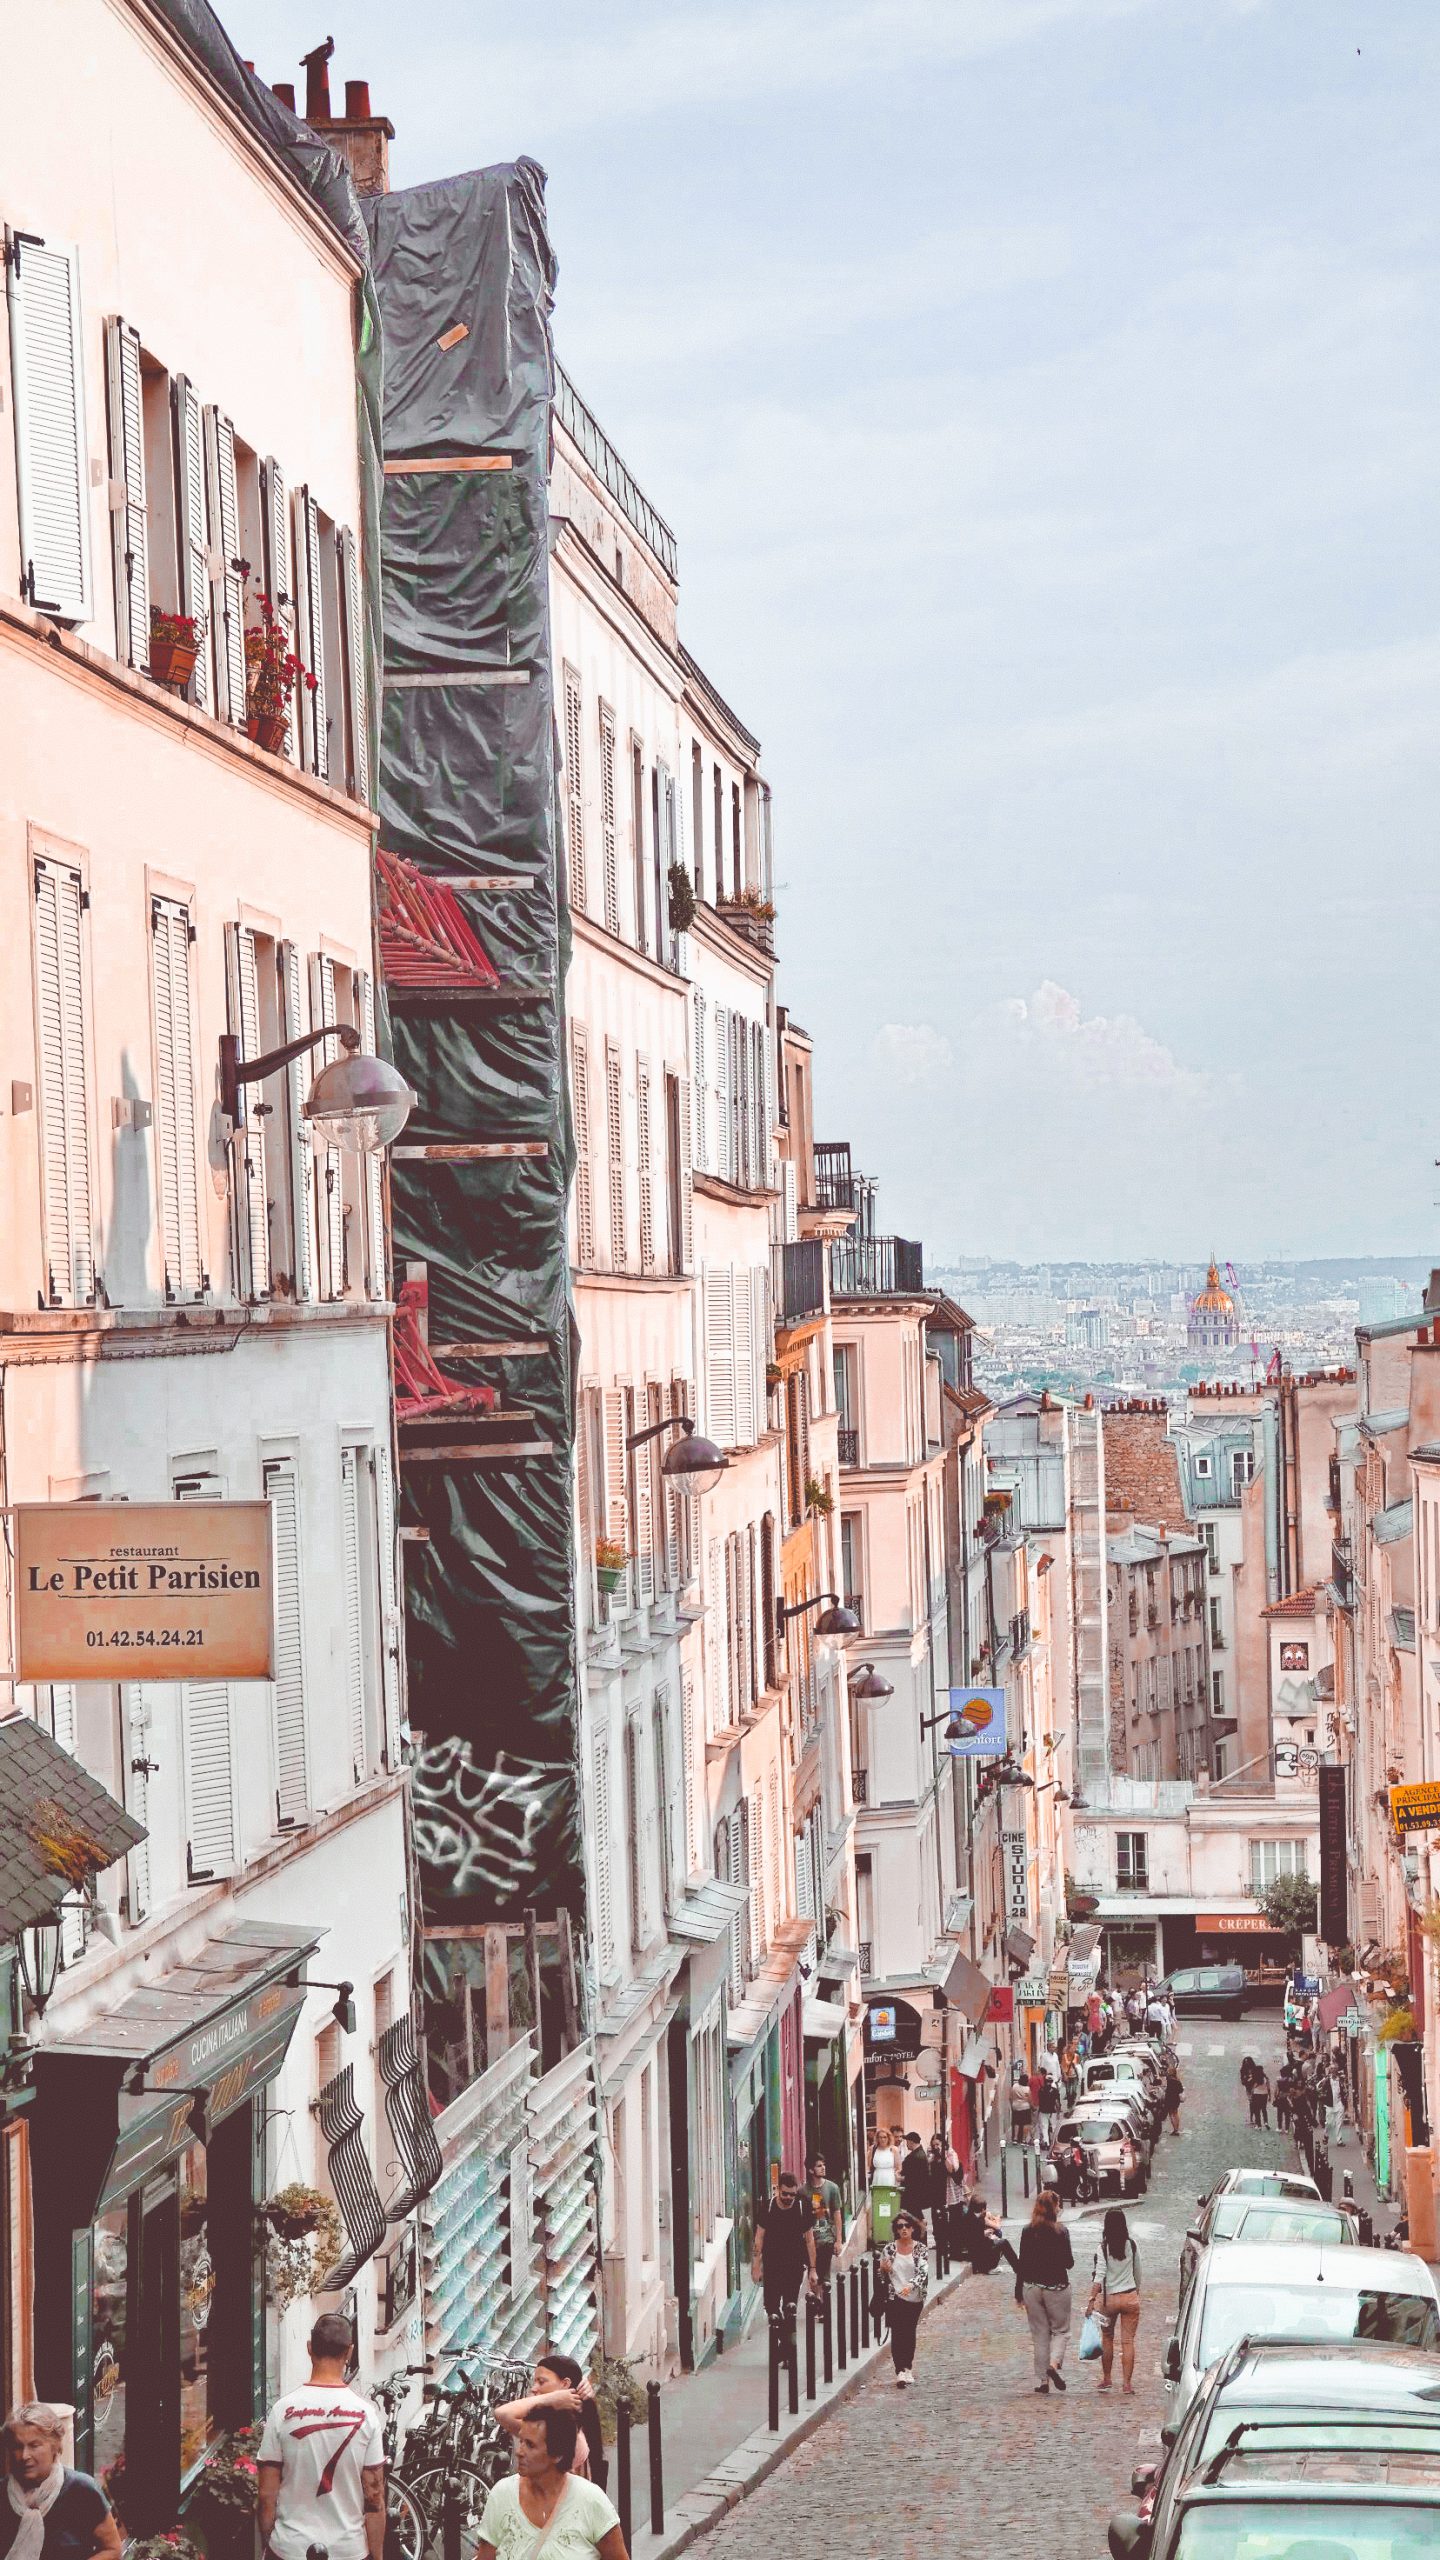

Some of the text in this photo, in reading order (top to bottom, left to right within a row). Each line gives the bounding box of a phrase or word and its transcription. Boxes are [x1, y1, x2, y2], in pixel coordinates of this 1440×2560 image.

[110, 1546, 180, 1557] restaurant
[28, 1563, 261, 1591] Le Petit Parisien
[86, 1629, 204, 1647] 01.42.54.24.21
[1002, 1833, 1024, 1843] CINE
[1011, 1844, 1025, 1905] STUDIO
[1011, 1907, 1026, 1918] 28
[191, 2009, 248, 2066] CUCINA ITALIANA
[289, 2416, 366, 2497] 7
